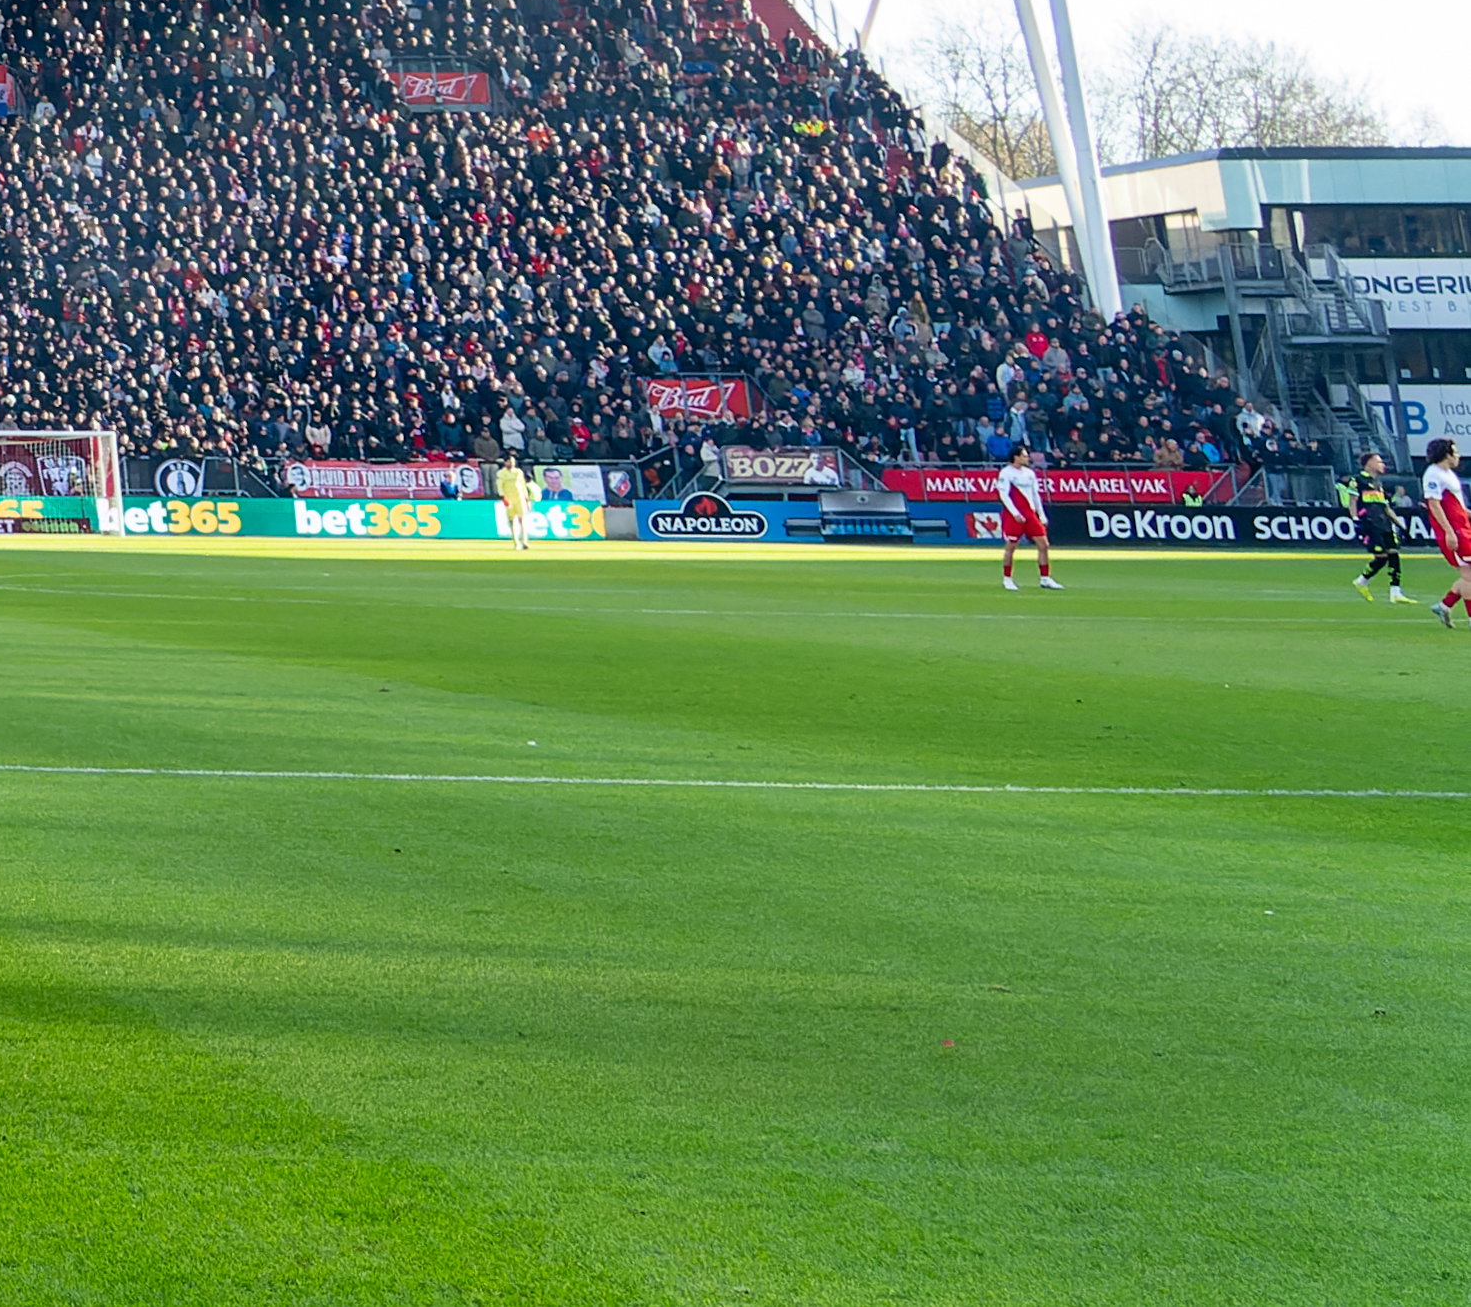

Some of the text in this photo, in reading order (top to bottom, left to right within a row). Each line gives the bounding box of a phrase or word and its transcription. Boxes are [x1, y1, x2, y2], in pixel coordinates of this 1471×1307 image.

[409, 77, 457, 96] Bud
[1351, 276, 1471, 294] ONGERI
[652, 385, 710, 408] Bud
[1368, 401, 1430, 435] TB
[312, 470, 345, 486] DAVID
[348, 470, 359, 486] DI
[926, 477, 976, 493] MARK
[978, 477, 1000, 492] VA
[1059, 478, 1130, 494] MAAREL
[1131, 479, 1166, 494] VAK
[97, 498, 241, 534] bet365
[294, 500, 441, 536] bet365
[656, 517, 759, 533] NAPOLEON
